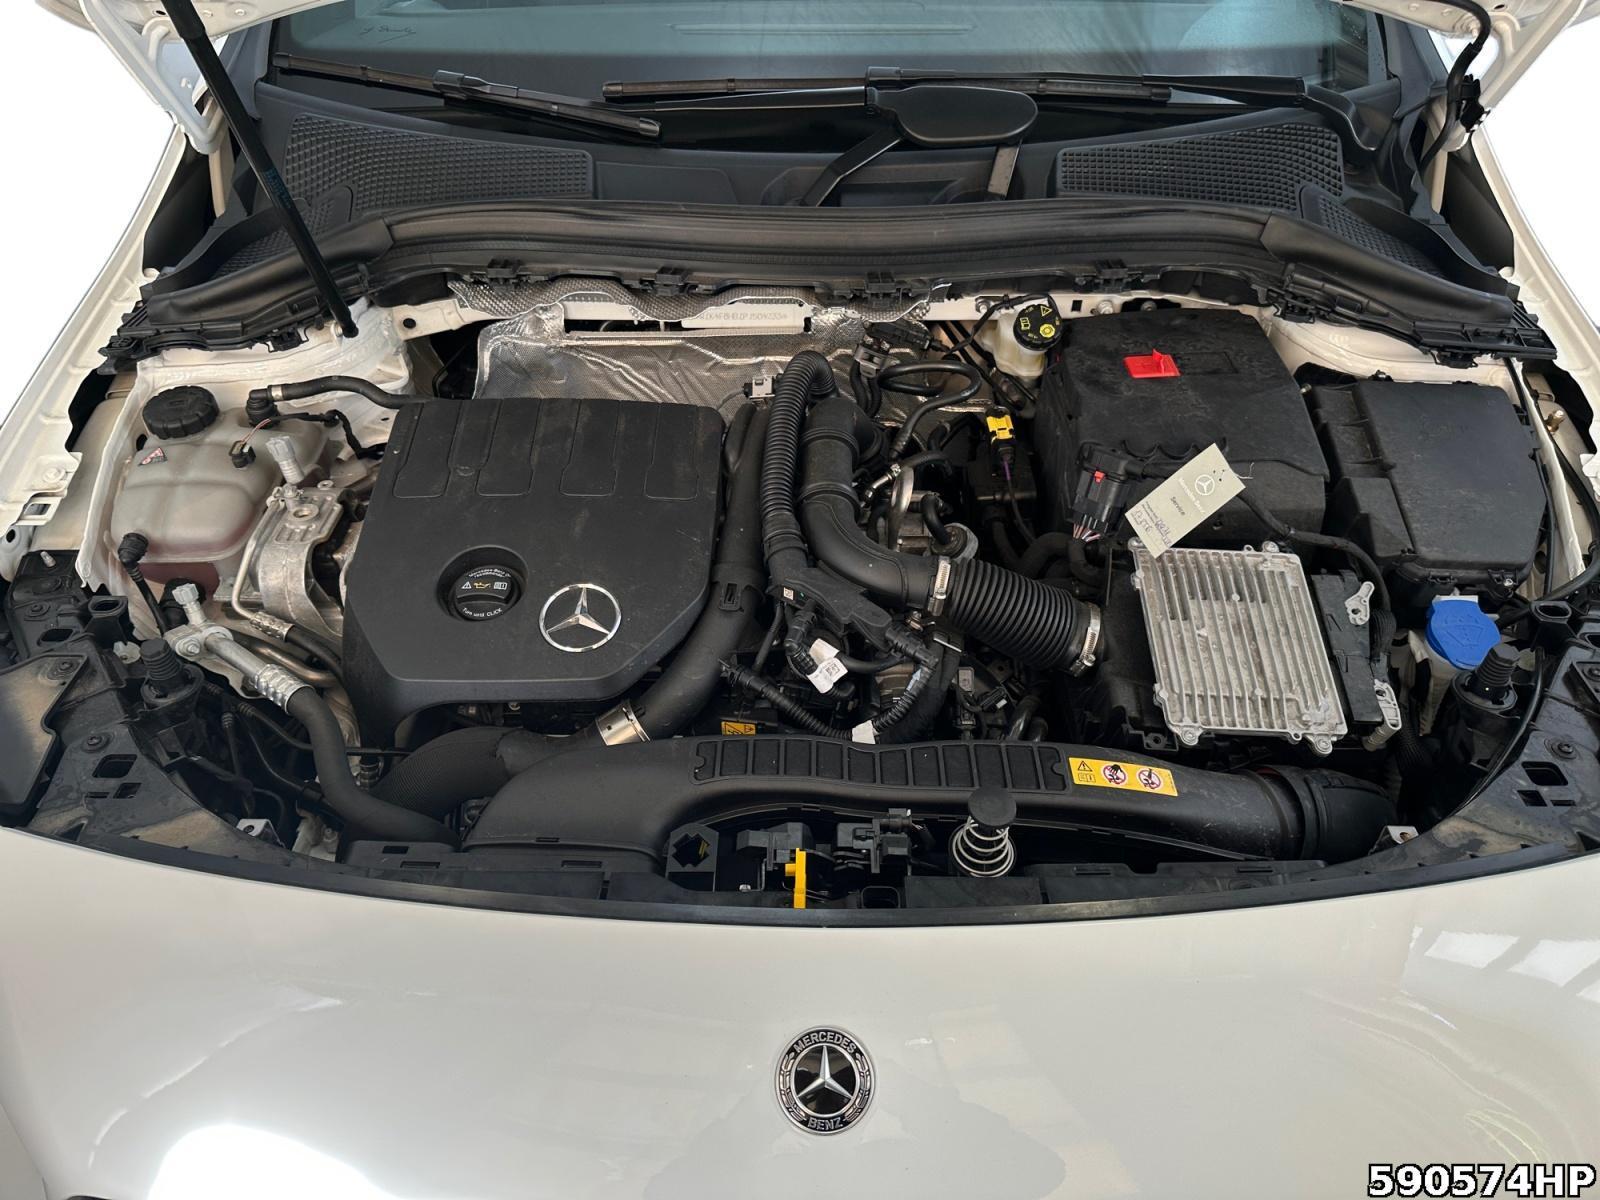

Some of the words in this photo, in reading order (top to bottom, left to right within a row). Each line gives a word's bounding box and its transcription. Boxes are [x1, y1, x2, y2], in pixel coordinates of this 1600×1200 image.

[1170, 496, 1185, 516] Service
[486, 607, 502, 617] CLICK
[793, 1031, 857, 1053] MERCEDES
[807, 1116, 844, 1131] BENZ
